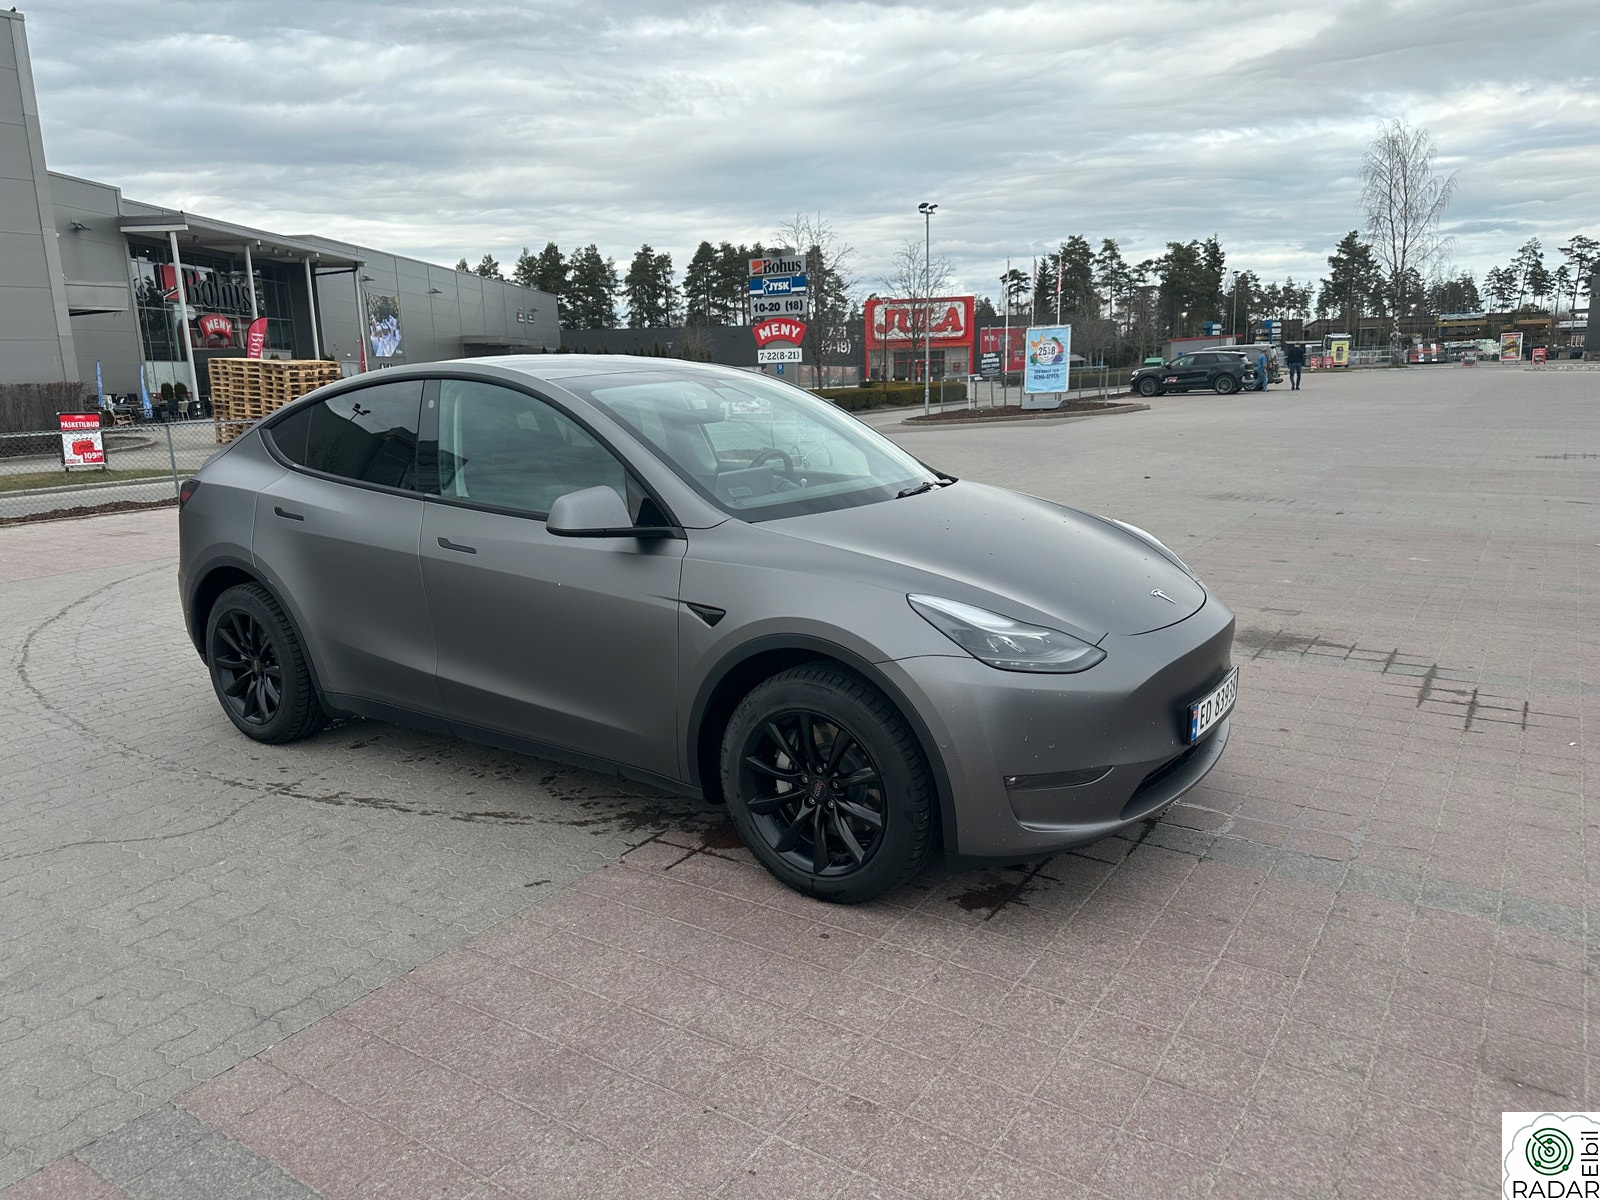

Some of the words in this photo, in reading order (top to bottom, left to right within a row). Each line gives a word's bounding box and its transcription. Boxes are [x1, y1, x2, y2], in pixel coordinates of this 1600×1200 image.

[763, 259, 802, 274] Bohus
[182, 267, 252, 311] Bohus
[768, 281, 790, 291] JYSK
[753, 302, 781, 313] 10-20
[785, 299, 803, 312] (18)
[205, 318, 231, 332] MENY
[875, 307, 963, 333] JULA
[758, 323, 801, 340] MENY
[1038, 347, 1047, 356] 25
[1051, 346, 1056, 355] 8
[1200, 700, 1211, 729] ED
